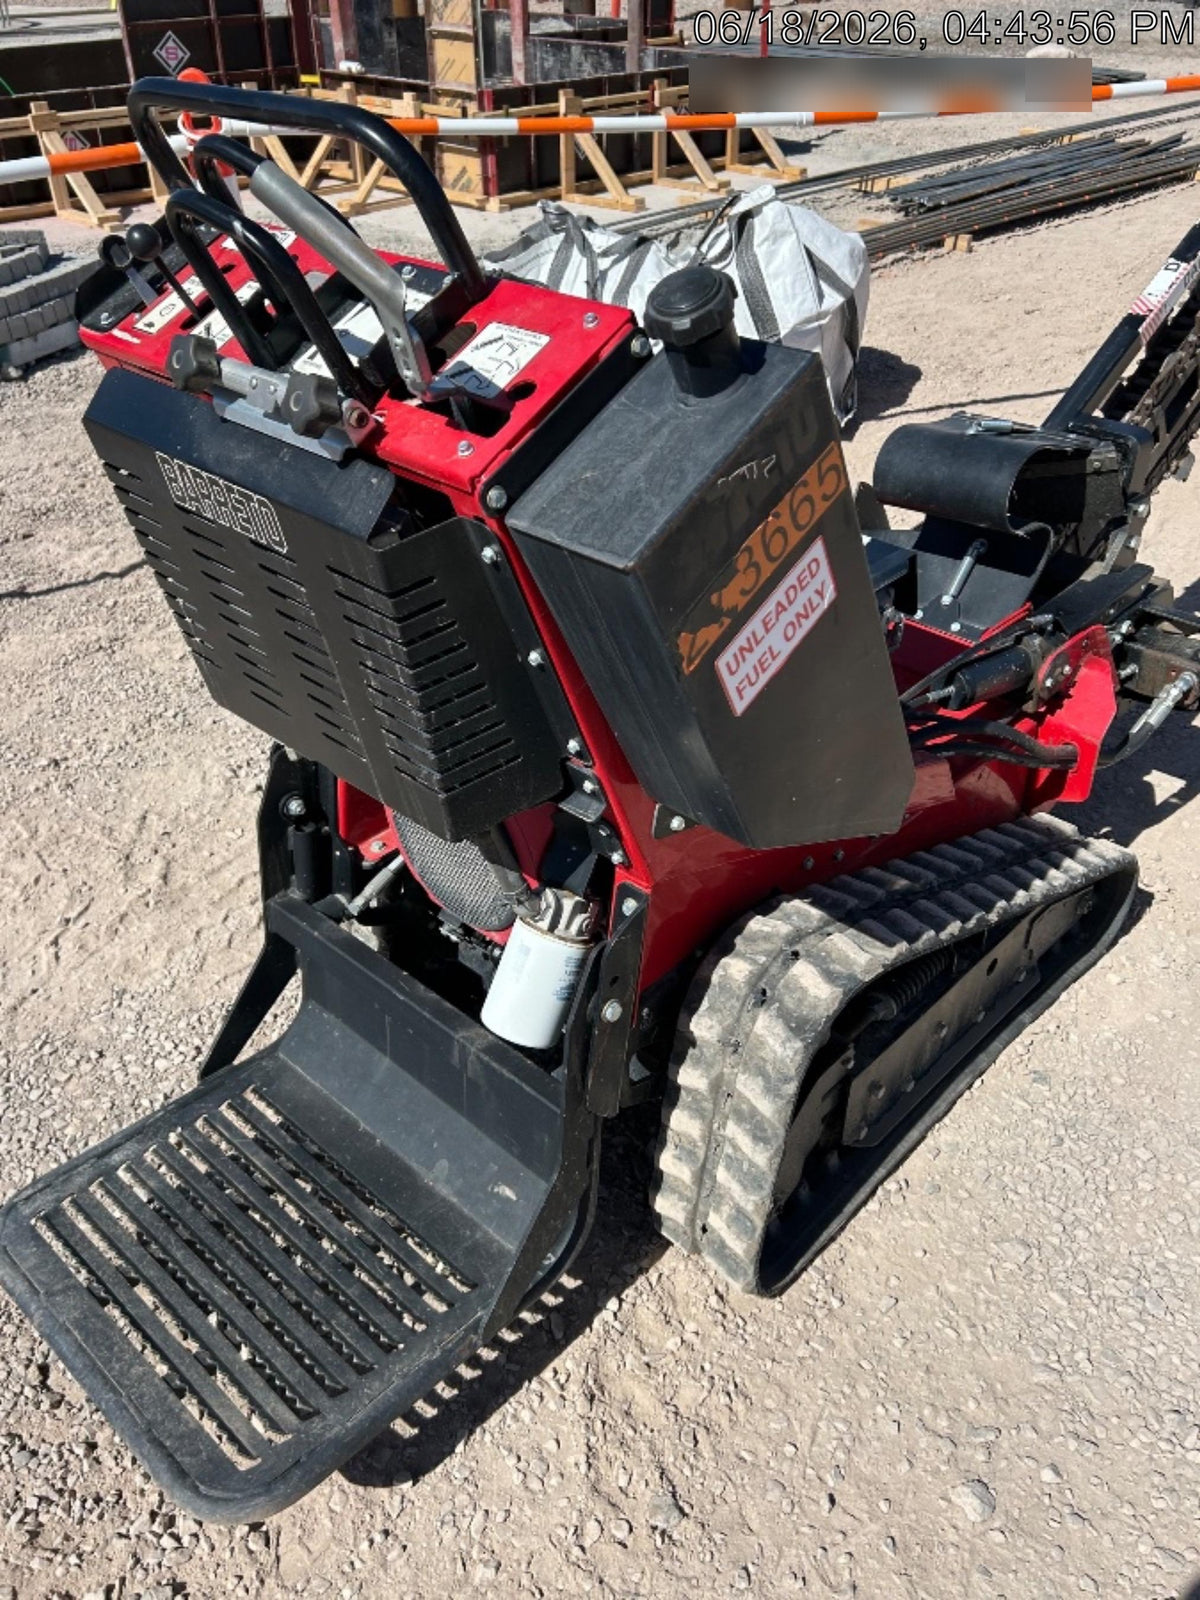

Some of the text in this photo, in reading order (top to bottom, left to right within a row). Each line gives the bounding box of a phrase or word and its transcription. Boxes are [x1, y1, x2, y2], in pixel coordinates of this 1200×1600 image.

[155, 450, 288, 554] BARRETO
[725, 558, 821, 677] UNLEADED
[735, 580, 826, 700] FUEL ONLY
